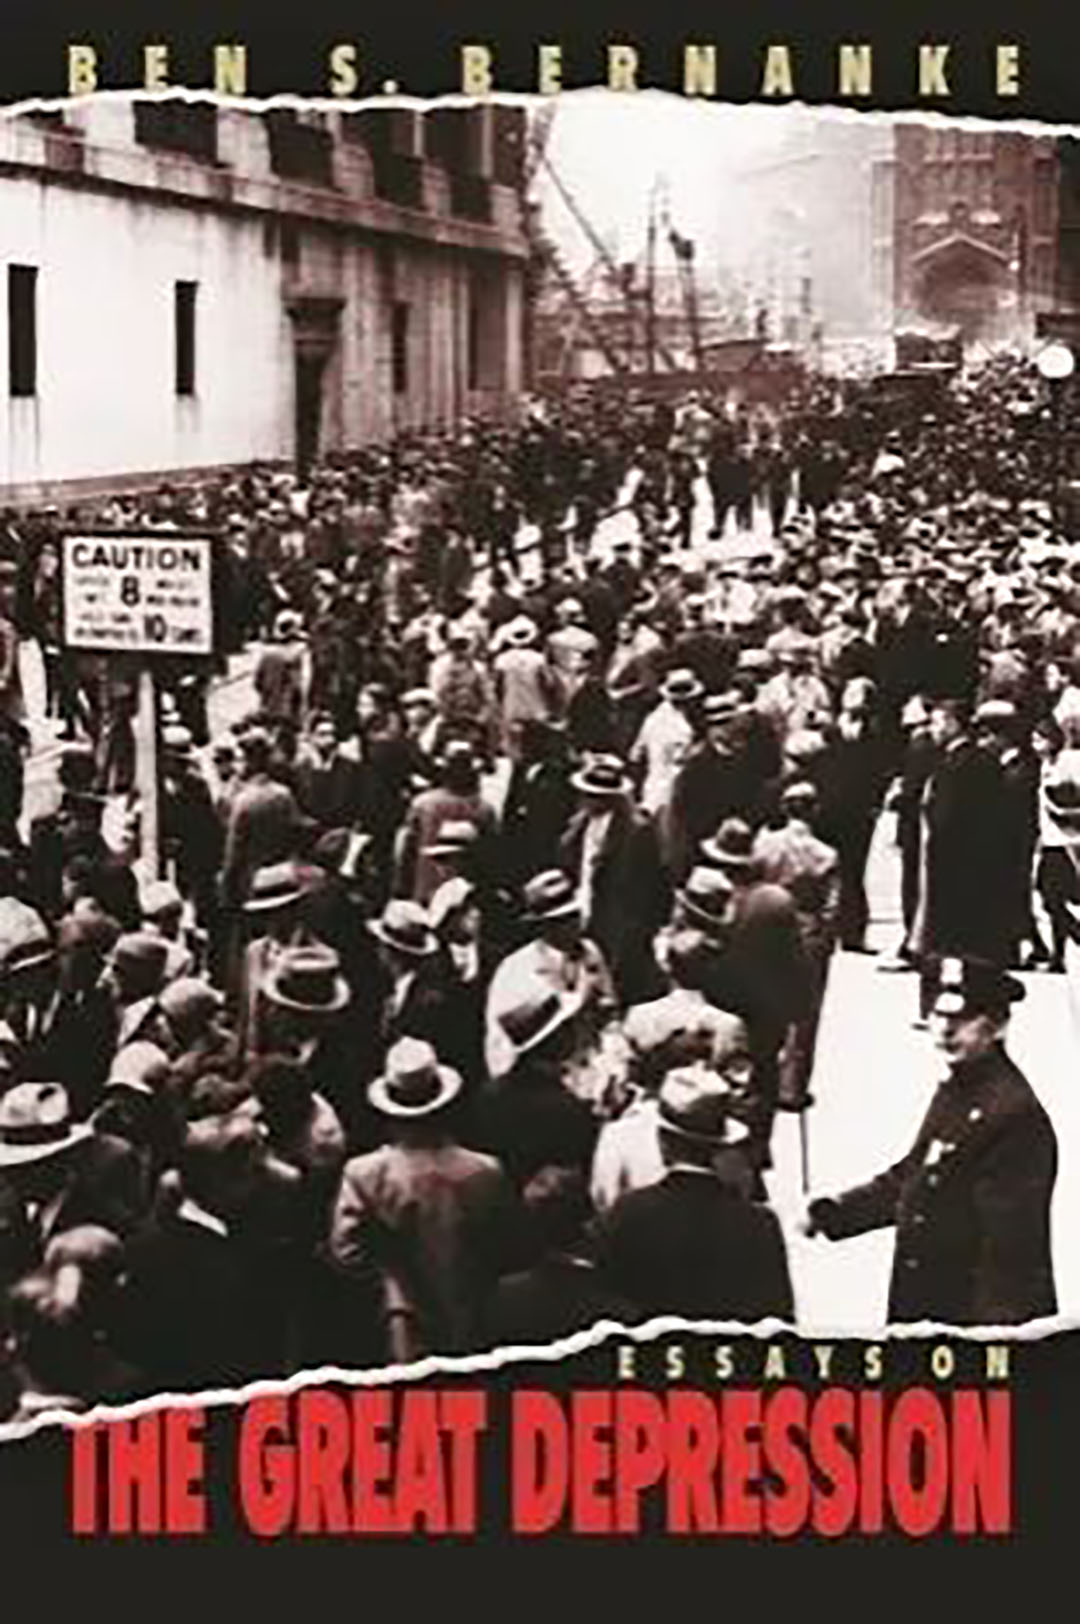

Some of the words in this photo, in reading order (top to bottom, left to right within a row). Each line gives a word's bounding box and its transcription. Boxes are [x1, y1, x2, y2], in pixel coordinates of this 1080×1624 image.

[68, 45, 247, 95] BEN
[329, 45, 398, 95] S.
[461, 45, 1019, 95] BERNANKE
[72, 543, 201, 571] CAUTION
[121, 576, 141, 607] 8
[618, 1345, 883, 1379] ESSAYS
[931, 1345, 1009, 1379] ON
[66, 1405, 206, 1533] THE
[240, 1389, 487, 1536] GREAT
[511, 1387, 1012, 1536] DEPRESSION
